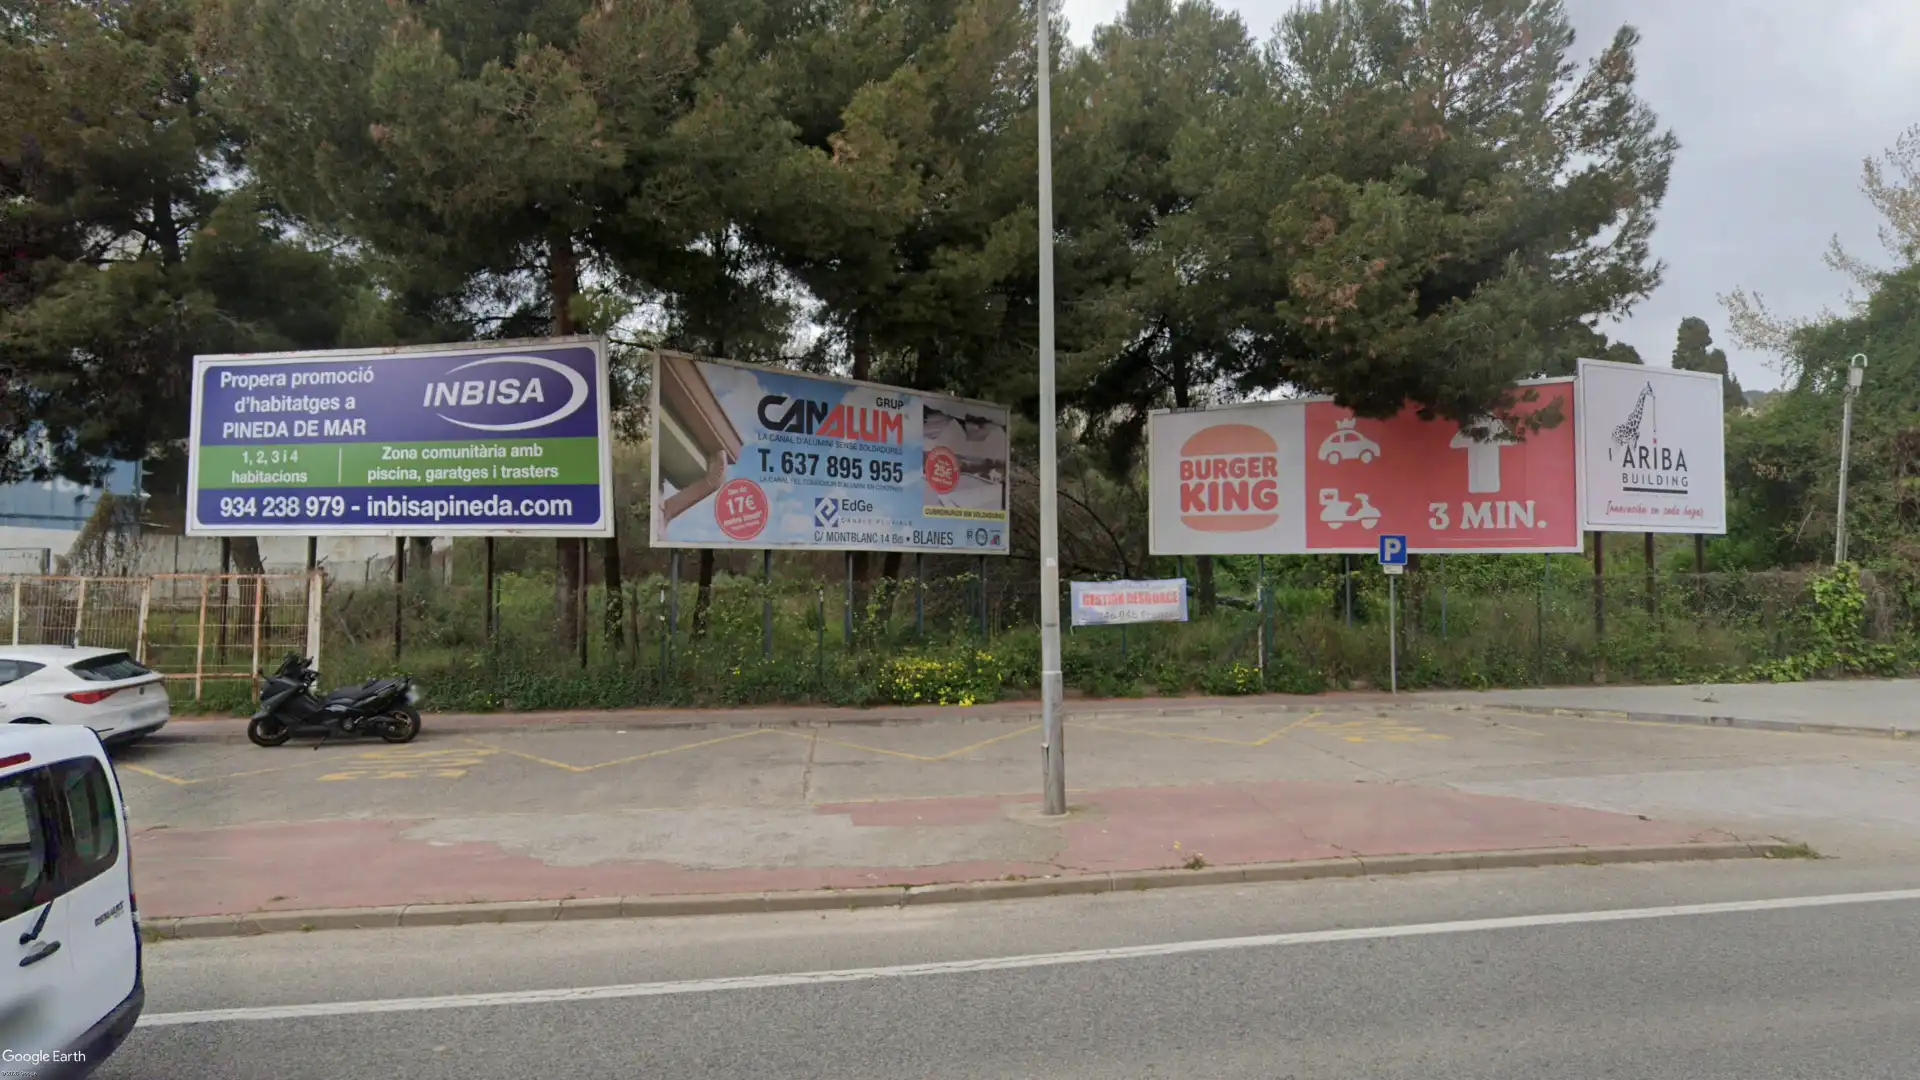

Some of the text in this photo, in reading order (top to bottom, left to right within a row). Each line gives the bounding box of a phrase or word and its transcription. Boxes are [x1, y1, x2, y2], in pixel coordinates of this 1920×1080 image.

[220, 366, 374, 390] Propera promoció
[423, 378, 545, 407] INBISA
[234, 395, 356, 414] d'habitatges a
[876, 397, 904, 410] GRUP
[222, 418, 366, 438] PINEDA DE MAR
[757, 394, 904, 446] CANALUM
[758, 432, 768, 442] LA
[770, 434, 795, 444] CANAL
[835, 442, 858, 450] SENSE
[242, 452, 252, 466] 1,
[256, 451, 268, 465] 2,
[271, 450, 280, 464] 3
[290, 450, 298, 463] 4
[382, 443, 544, 460] Zona comunitària amb
[368, 466, 422, 483] piscina,
[425, 466, 488, 482] garatges
[500, 464, 559, 479] trasters
[758, 448, 774, 473] T.
[781, 451, 820, 476] 637
[826, 455, 862, 480] 895
[868, 460, 904, 484] 955
[1180, 456, 1278, 480] BURGER
[232, 470, 308, 484] habitacions
[1622, 472, 1688, 487] BUILDING
[726, 494, 756, 515] 17€
[842, 498, 874, 512] EdGe
[1180, 480, 1278, 512] KING
[220, 496, 257, 518] 934
[262, 496, 300, 518] 238
[305, 496, 344, 517] 979
[367, 494, 572, 521] inbisapineda.com
[1428, 500, 1548, 530] 3 MIN.
[1650, 507, 1660, 515] en
[1663, 504, 1680, 516] cada
[814, 530, 954, 546] C/ MONTBLANC 14 Bis BLANES
[1384, 538, 1402, 562] P
